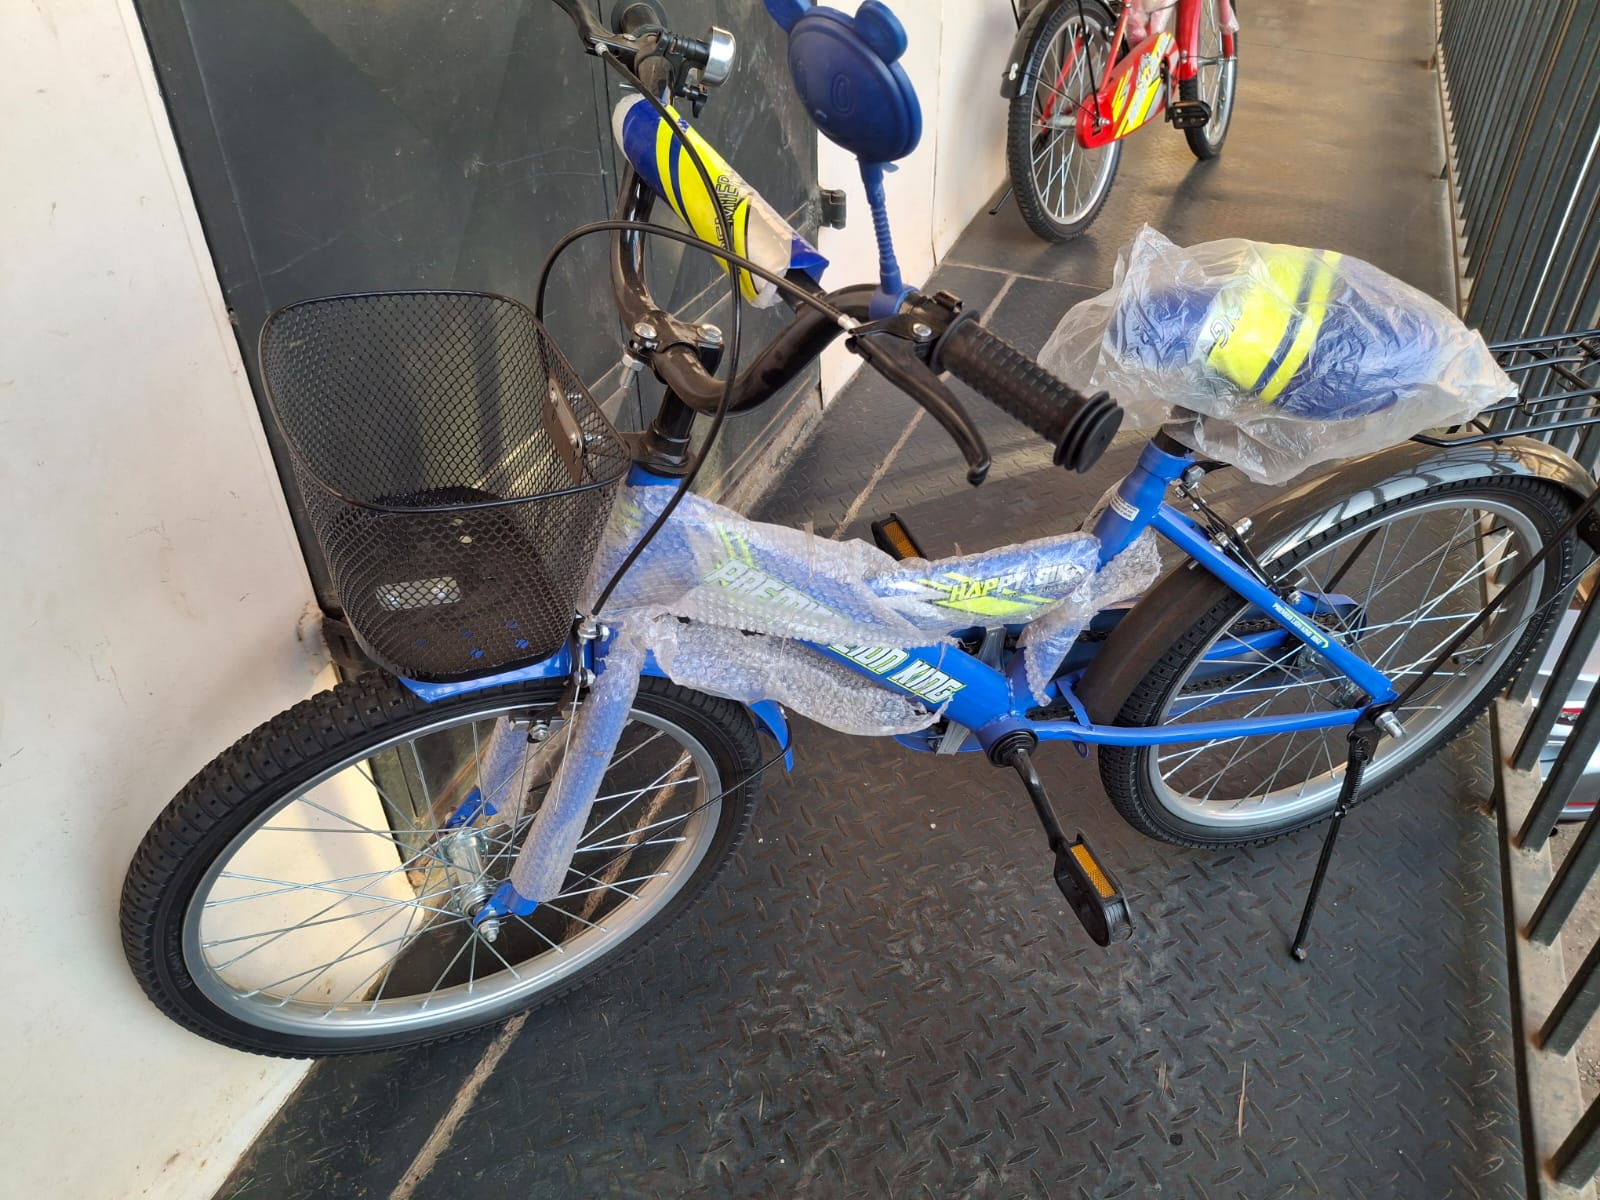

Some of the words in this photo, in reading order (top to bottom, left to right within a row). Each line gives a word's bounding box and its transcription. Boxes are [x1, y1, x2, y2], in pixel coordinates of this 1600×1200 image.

[950, 571, 1031, 601] HAPPY
[828, 645, 910, 675] ION
[886, 657, 967, 704] KING
